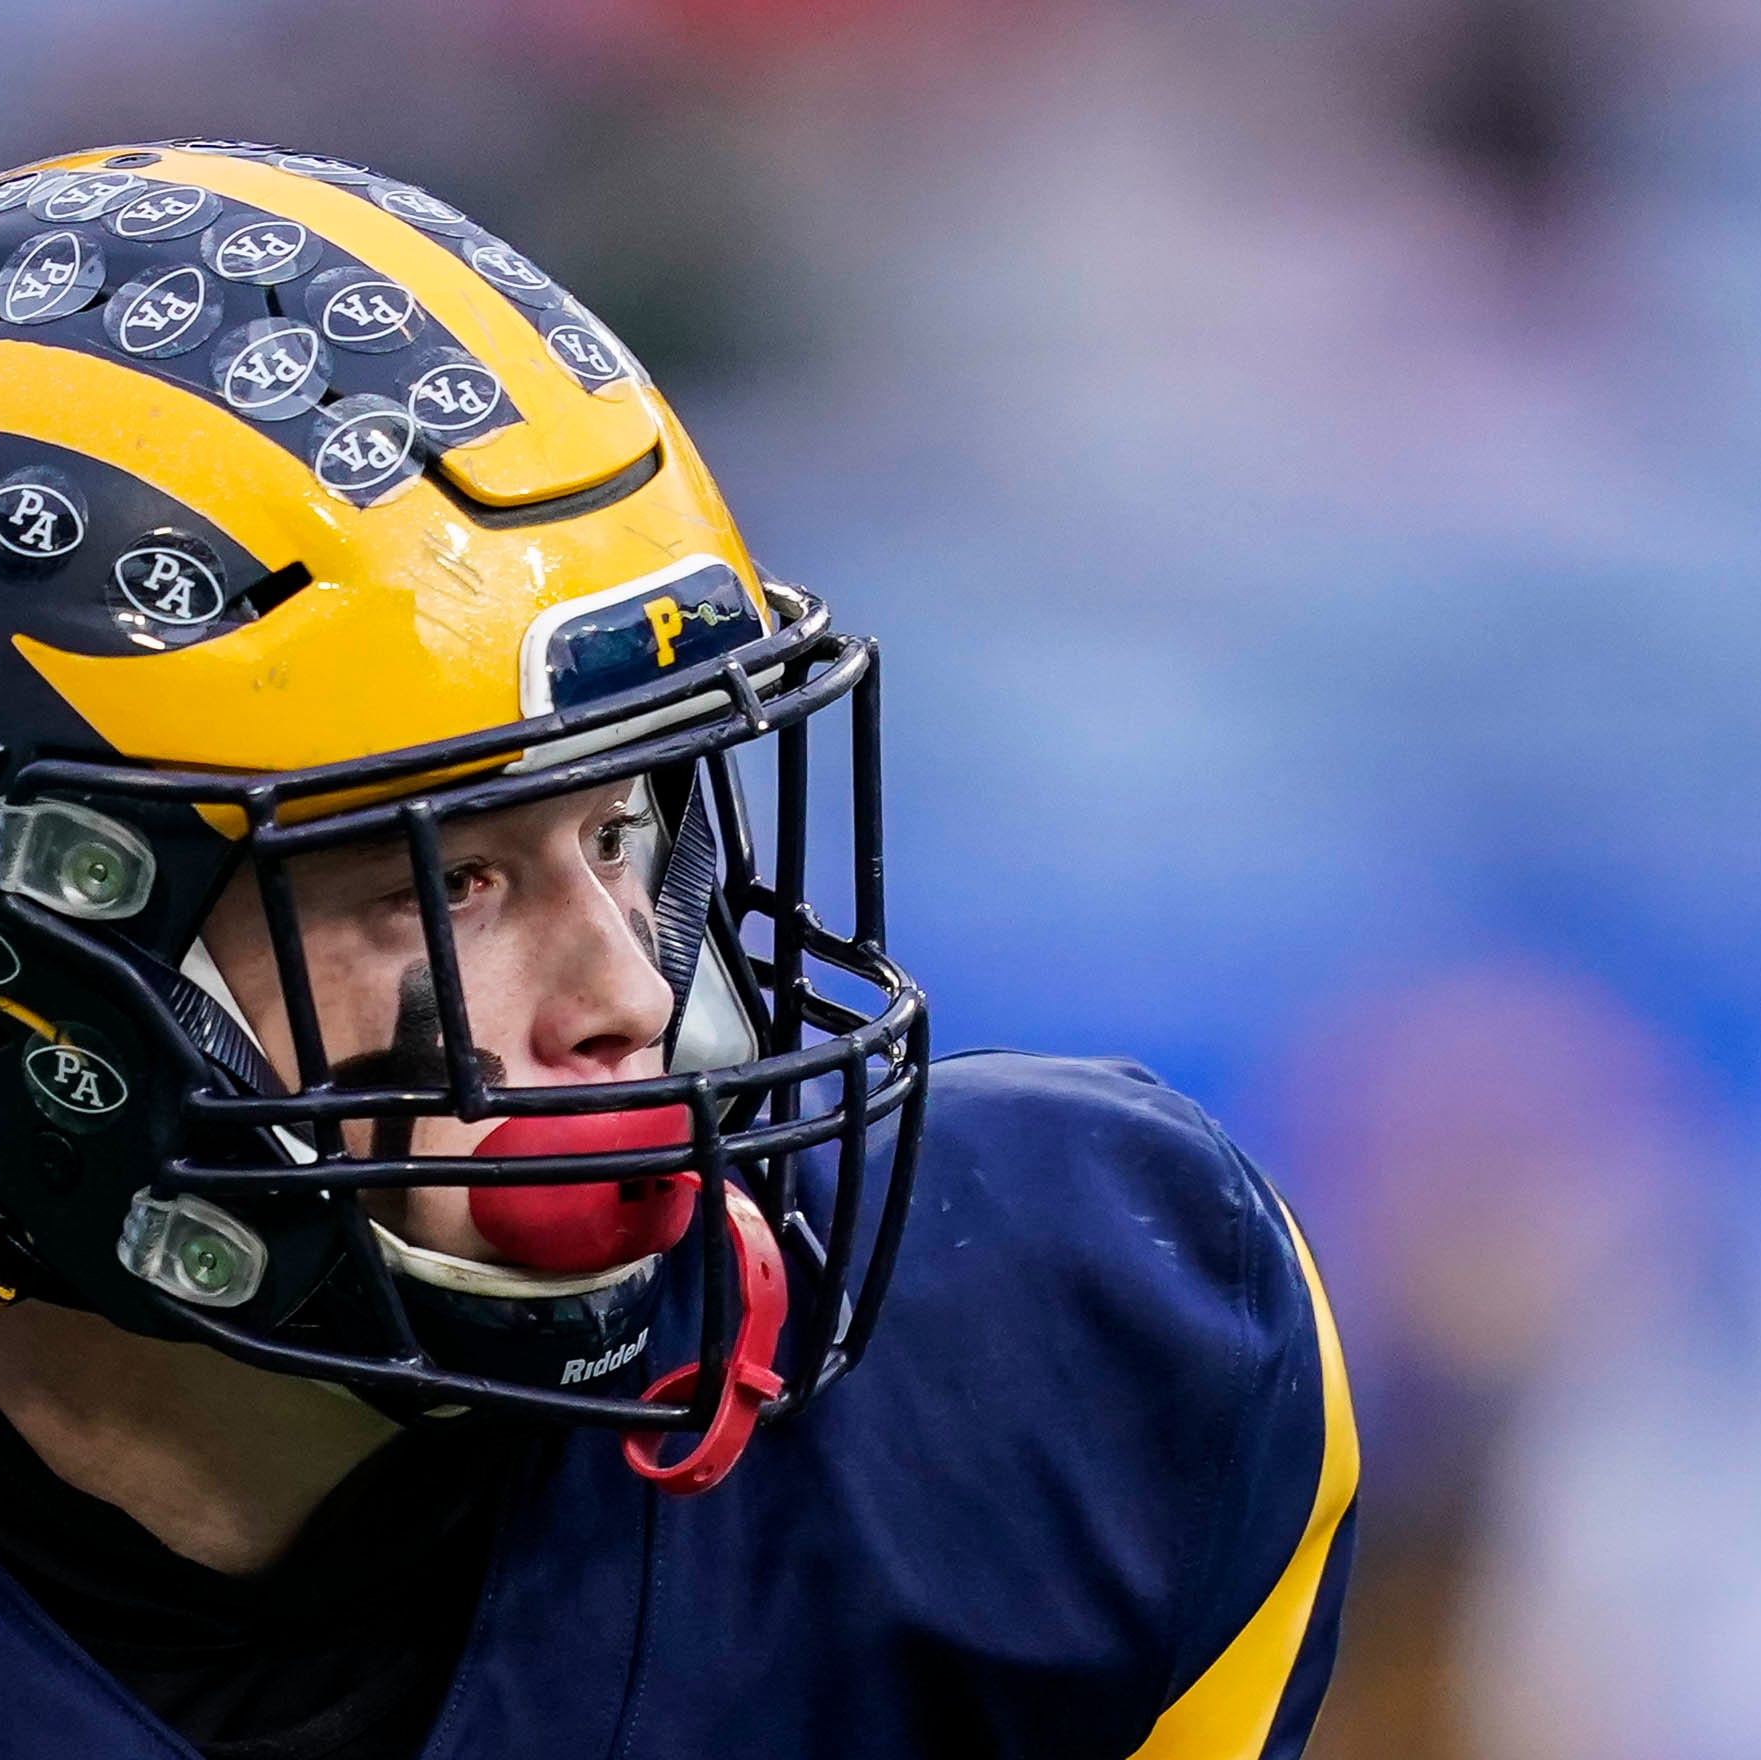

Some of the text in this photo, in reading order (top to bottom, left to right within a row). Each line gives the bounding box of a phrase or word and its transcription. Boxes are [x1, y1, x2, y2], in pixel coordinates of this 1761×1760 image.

[53, 181, 120, 206] PA
[123, 196, 195, 222] PA
[387, 194, 458, 221] PA
[224, 232, 297, 263] PA
[11, 257, 75, 302] PA
[478, 253, 544, 285] PA
[127, 291, 197, 331] PA
[332, 293, 404, 327] PA
[233, 348, 307, 389] PA
[554, 333, 615, 374] PA
[417, 376, 490, 416] PA
[326, 429, 401, 473] PA
[8, 489, 58, 551] PA
[143, 552, 196, 618] PA
[643, 596, 684, 668] P
[53, 1050, 105, 1108] PA
